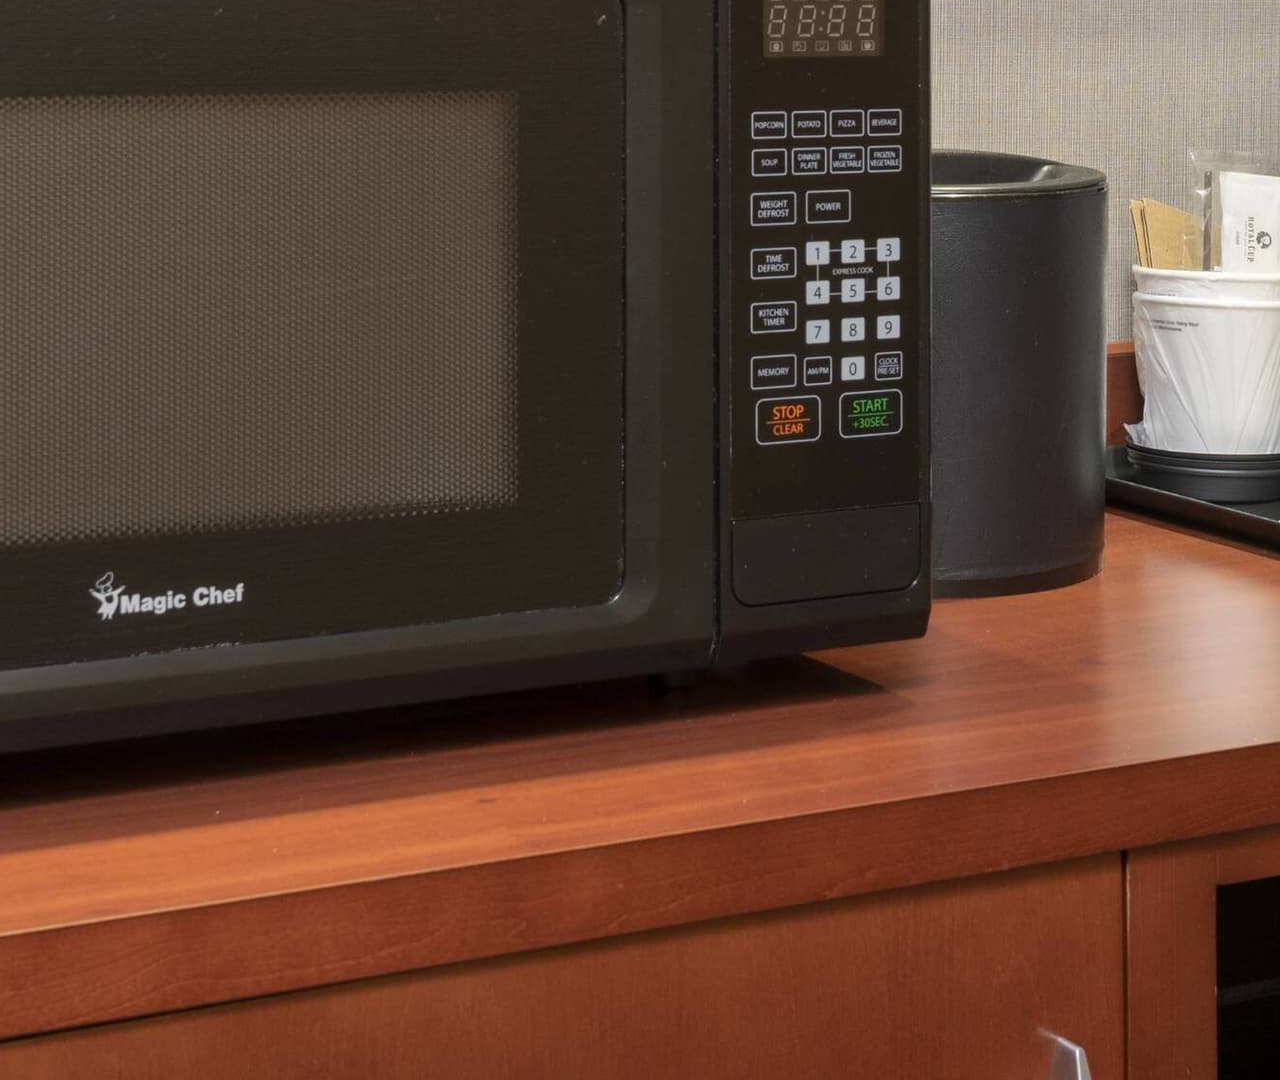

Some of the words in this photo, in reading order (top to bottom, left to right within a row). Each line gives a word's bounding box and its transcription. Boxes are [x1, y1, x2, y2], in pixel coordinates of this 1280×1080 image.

[754, 120, 785, 129] POPCORN
[797, 120, 821, 129] POTATO
[837, 119, 856, 128] PIZZA
[871, 118, 897, 127] BEVERAGE
[797, 152, 821, 161] DINNER
[838, 151, 856, 160] FRESH
[873, 150, 896, 159] FROZEN
[761, 158, 779, 167] SOUP
[800, 161, 819, 170] PLATE
[760, 200, 788, 209] WEIGHT
[815, 202, 842, 211] POWER
[757, 209, 790, 219] DEFROST
[814, 247, 821, 261] 1
[849, 245, 857, 259] 2
[885, 243, 893, 257] 3
[765, 254, 783, 263] TIME
[757, 263, 790, 273] DEFROST
[832, 267, 857, 276] EXPRESS
[856, 266, 874, 274] COOK
[813, 286, 822, 300] 4
[849, 284, 857, 298] 5
[884, 282, 893, 296] 6
[758, 308, 789, 318] KITCHEN
[763, 317, 785, 326] TIMER
[813, 325, 822, 339] 7
[849, 323, 857, 337] 8
[884, 320, 893, 334] 9
[757, 367, 790, 377] MEMORY
[848, 362, 857, 376] 0
[852, 398, 889, 414] START
[772, 404, 804, 420] STOP
[772, 423, 804, 436] CLEAR
[120, 590, 186, 615] Magic
[192, 582, 245, 607] Chef
